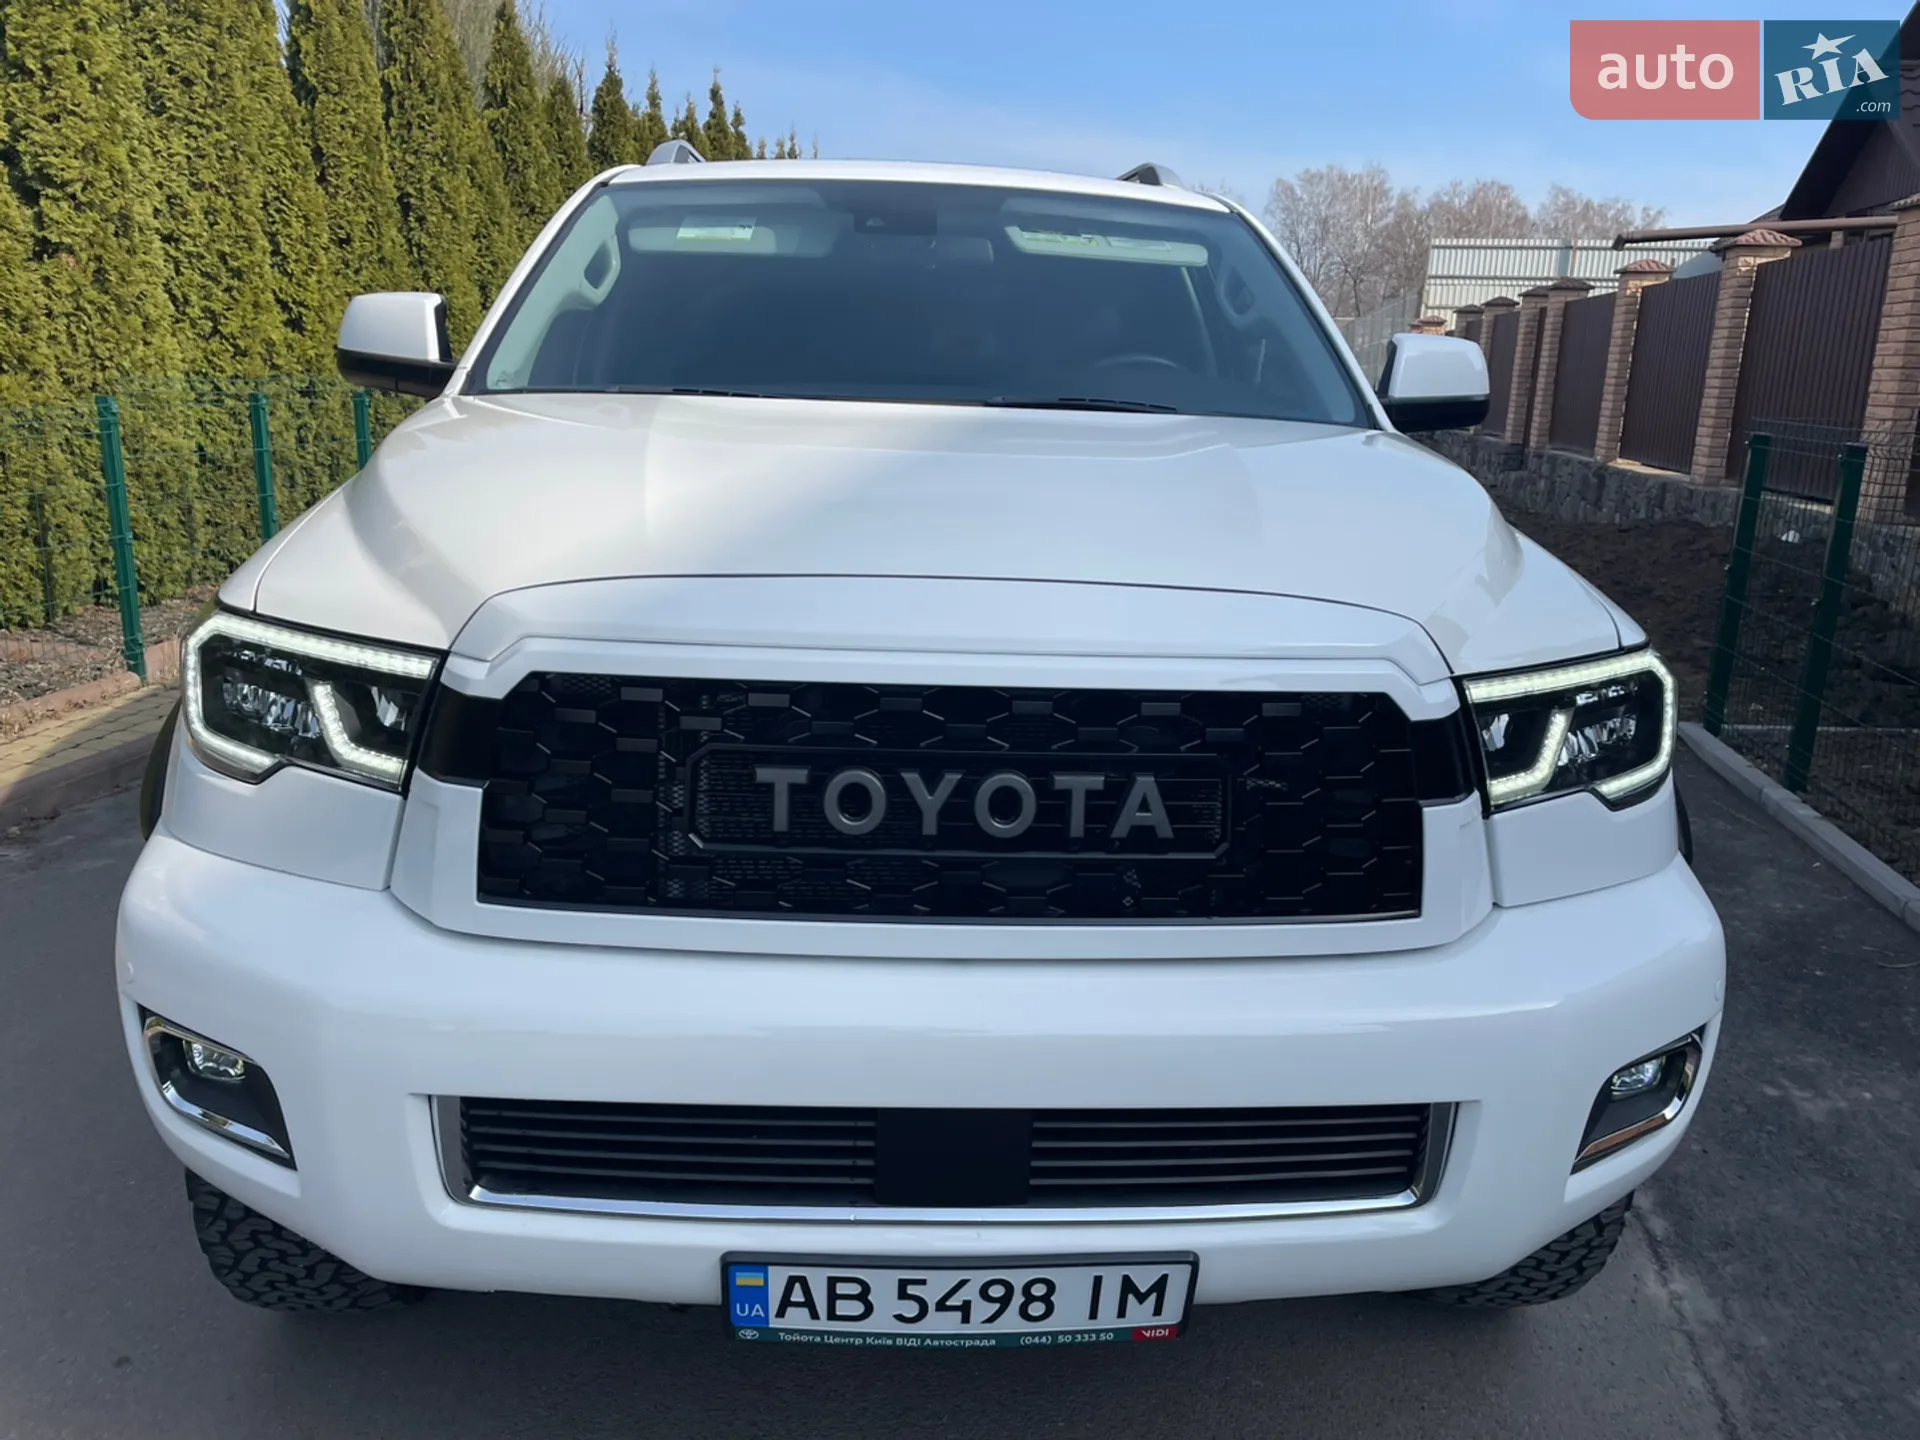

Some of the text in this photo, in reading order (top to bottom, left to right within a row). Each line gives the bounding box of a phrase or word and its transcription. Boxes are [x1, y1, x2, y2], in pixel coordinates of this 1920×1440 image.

[754, 766, 1175, 839] TOYOTA
[774, 1273, 1170, 1324] AB 5498 IM
[736, 1303, 765, 1317] UA
[778, 1332, 821, 1343] Тойота
[824, 1334, 863, 1345] Центр
[866, 1336, 893, 1345] Київ
[923, 1337, 996, 1347] Автострада
[1141, 1328, 1169, 1338] VIDI
[1020, 1336, 1053, 1346] (044)
